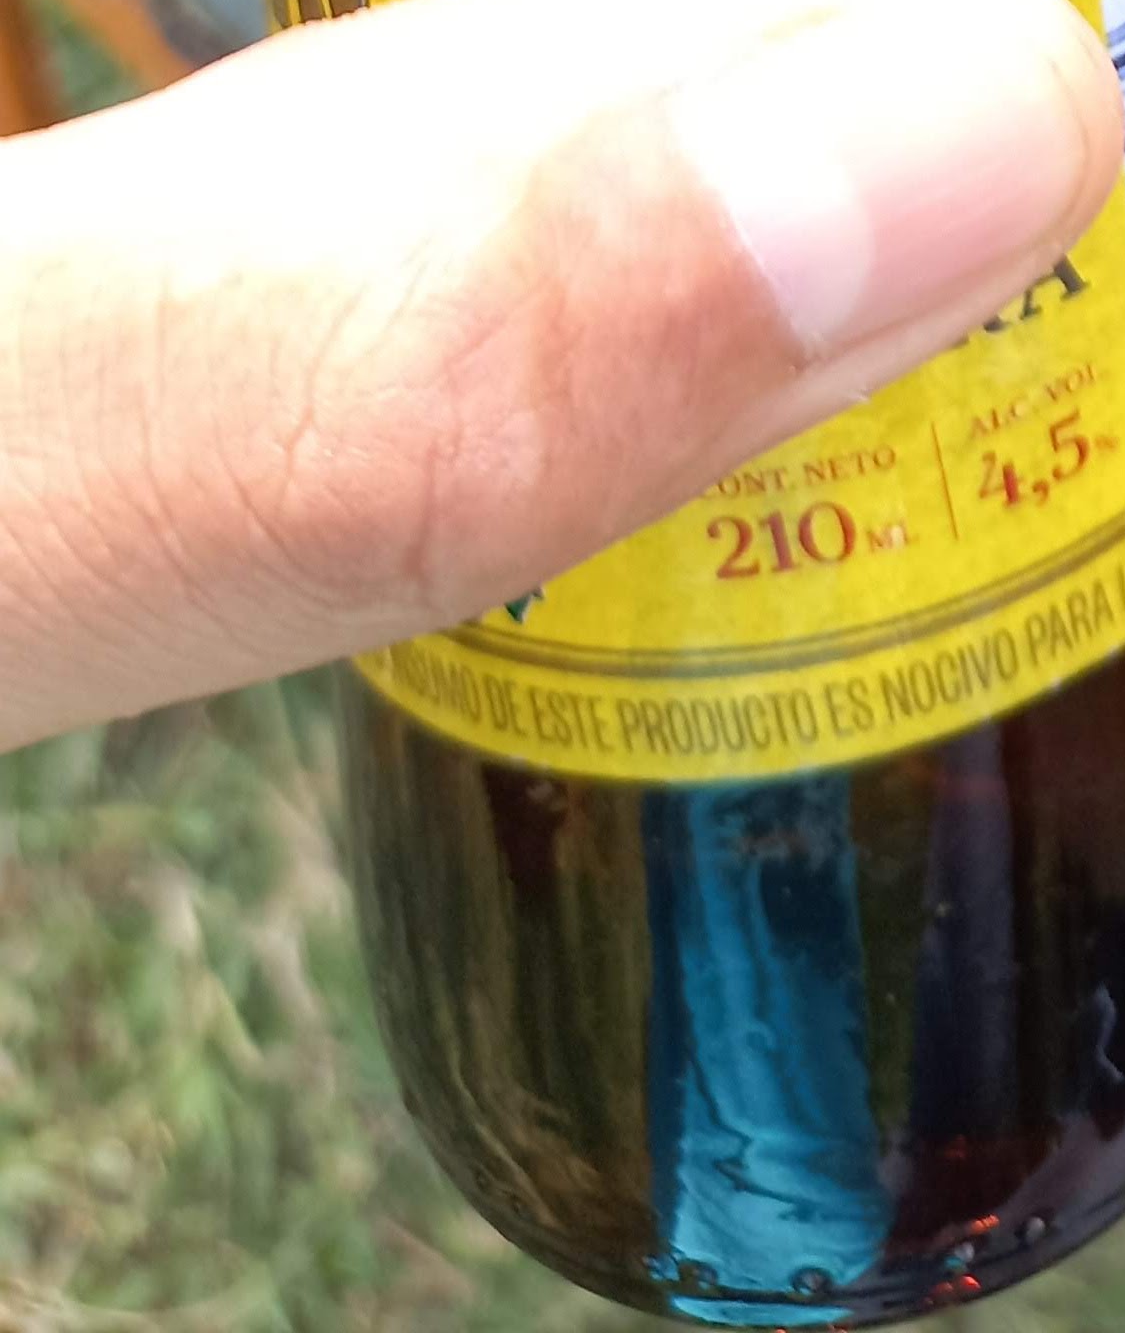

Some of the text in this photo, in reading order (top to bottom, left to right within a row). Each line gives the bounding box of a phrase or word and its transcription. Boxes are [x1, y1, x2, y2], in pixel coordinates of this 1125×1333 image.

[802, 444, 897, 486] NETO
[706, 500, 857, 580] 210
[483, 674, 528, 738] DE
[528, 684, 614, 753] ESTE
[616, 688, 820, 756] PRODUCTO
[824, 677, 876, 737] ES
[877, 627, 1019, 724] NOCIVO
[1024, 578, 1115, 668] PARA
